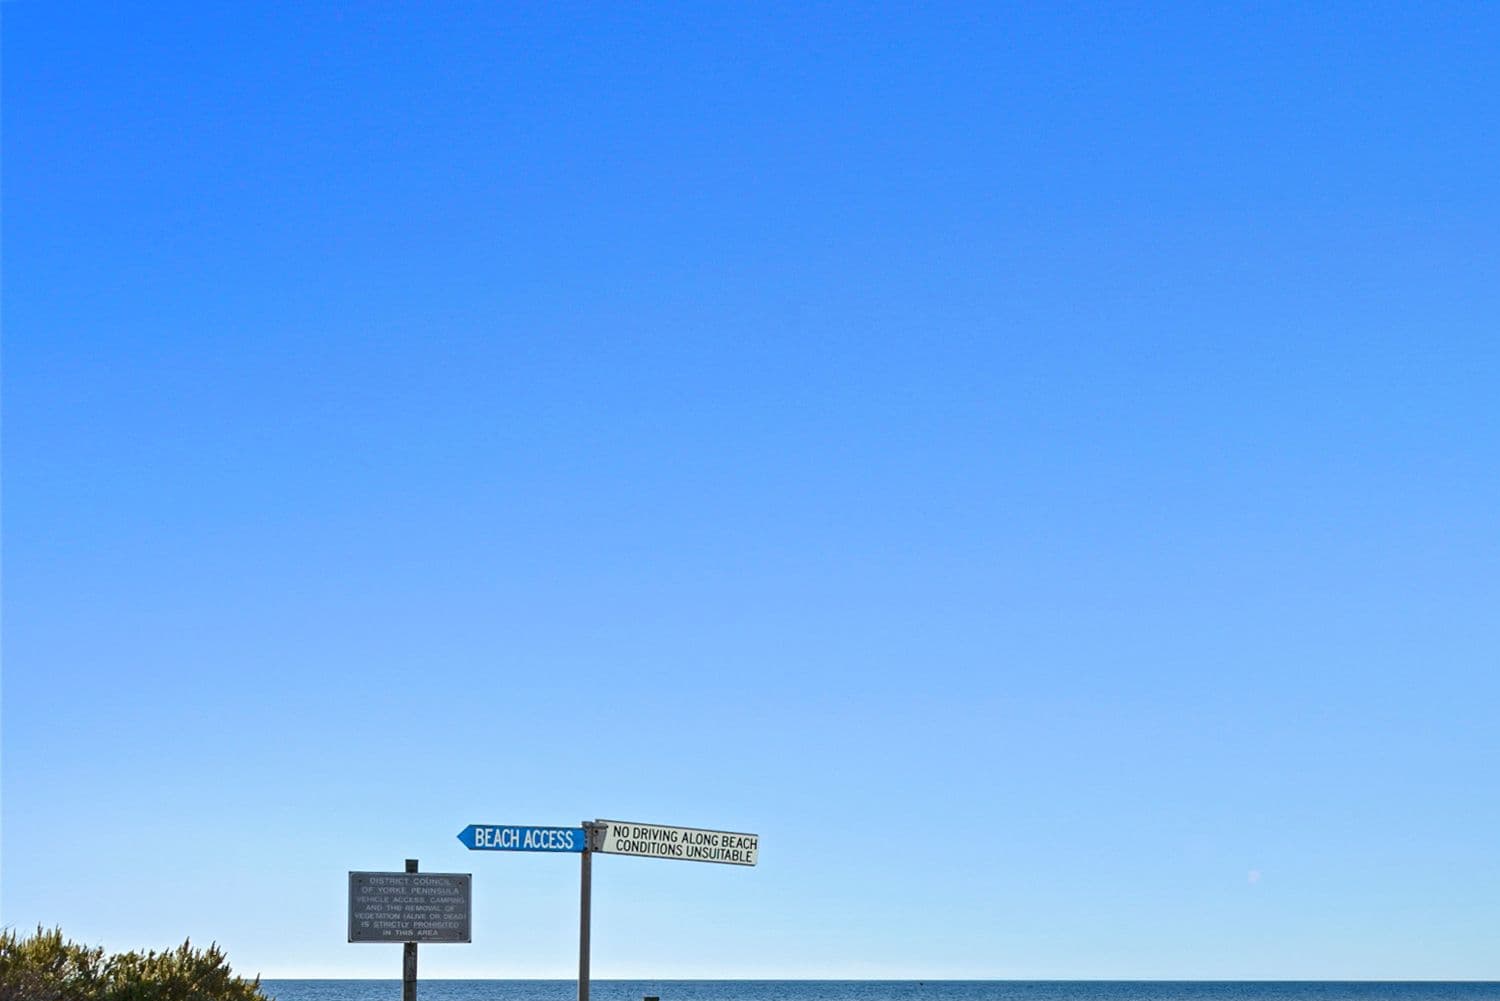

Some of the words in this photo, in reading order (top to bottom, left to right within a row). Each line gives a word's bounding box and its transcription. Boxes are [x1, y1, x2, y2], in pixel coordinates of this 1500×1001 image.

[475, 828, 520, 848] BEACH
[523, 829, 574, 849] ACCESS
[613, 825, 630, 838] NO
[633, 827, 679, 843] DRIVING
[681, 832, 719, 847] ALONG
[721, 835, 758, 850] BEACH
[616, 839, 683, 857] CONDITIONS
[686, 846, 753, 863] UNSUITABLE
[369, 877, 409, 885] DISTRICT
[413, 877, 452, 886] COUNCIL
[361, 886, 374, 894] OF
[411, 887, 459, 895] PENINSULA
[366, 904, 383, 912] AND
[386, 904, 402, 912] THE
[405, 904, 441, 912] REMOVAL
[354, 912, 401, 920] VEGETATION
[373, 921, 409, 929] STRICTLY
[413, 921, 460, 929] PROHIBITED
[395, 929, 414, 937] THIS
